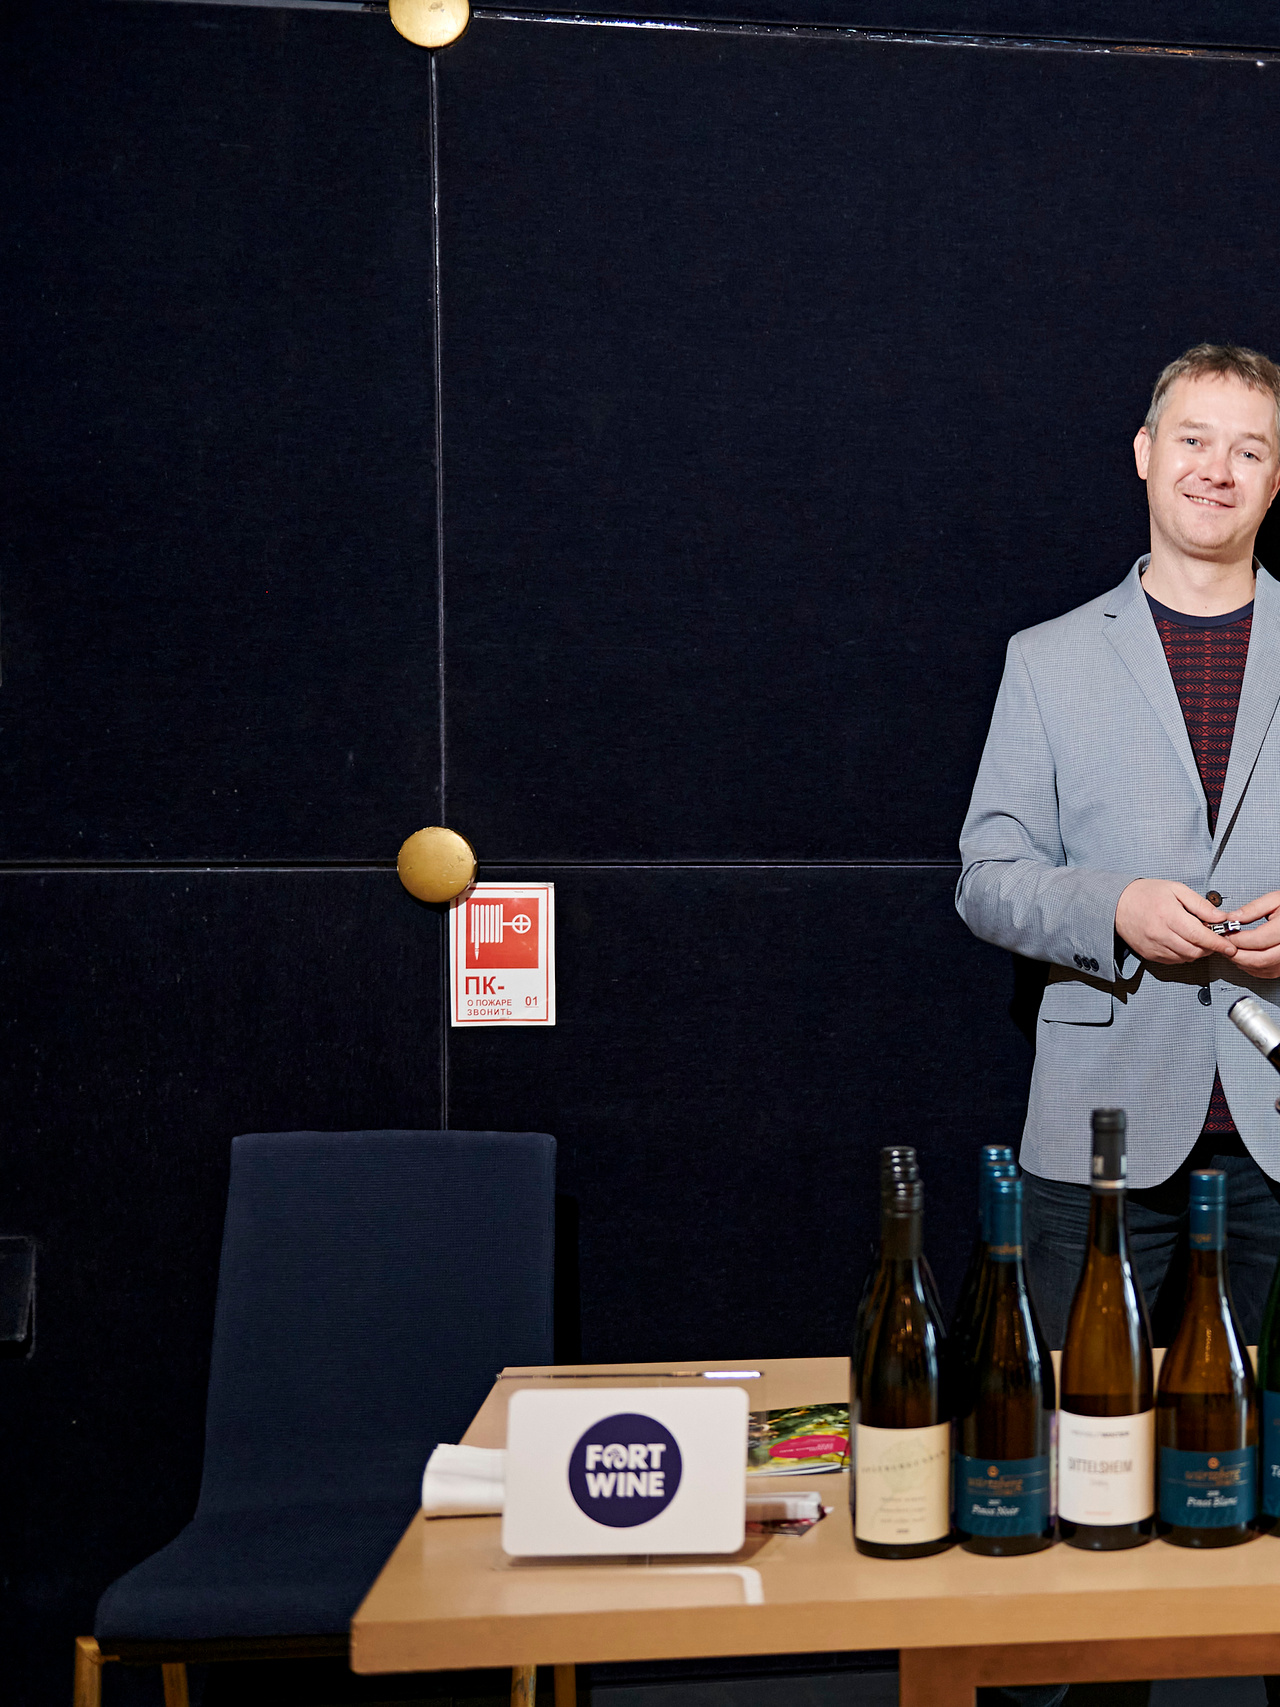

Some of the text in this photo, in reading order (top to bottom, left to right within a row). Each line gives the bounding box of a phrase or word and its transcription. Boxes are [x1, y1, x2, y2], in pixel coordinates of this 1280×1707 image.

[465, 976, 505, 995] ПК-
[467, 999, 512, 1007] О ПОЖАРЕ
[525, 996, 539, 1006] 01
[467, 1008, 513, 1016] ЗВОНИТЬ
[585, 1443, 667, 1470] FORT
[585, 1472, 666, 1498] WINE
